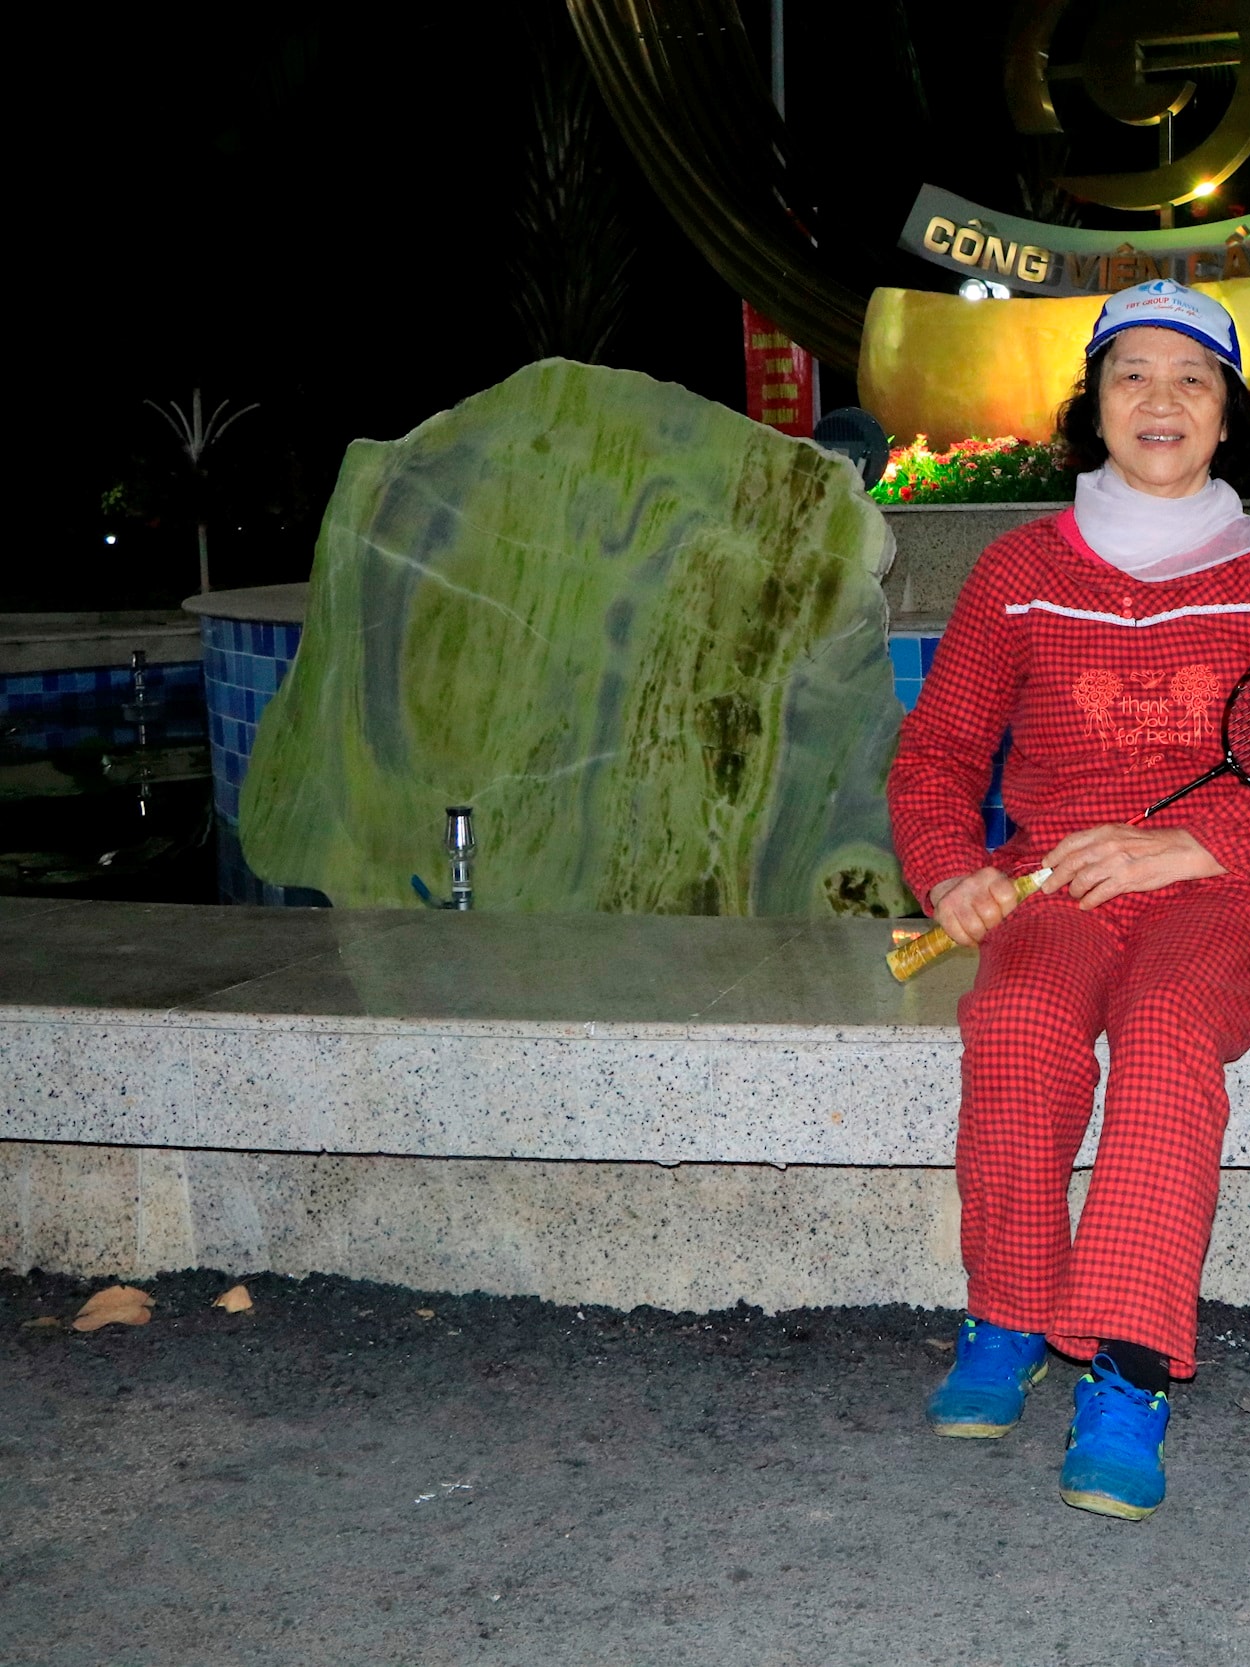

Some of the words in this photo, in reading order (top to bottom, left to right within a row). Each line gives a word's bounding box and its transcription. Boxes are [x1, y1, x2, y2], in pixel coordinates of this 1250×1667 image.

[924, 216, 1049, 283] CÔNG
[1142, 296, 1170, 306] GROUP
[1118, 695, 1170, 715] thank
[1131, 715, 1169, 733] you
[1115, 727, 1143, 748] for
[1146, 728, 1191, 746] being
